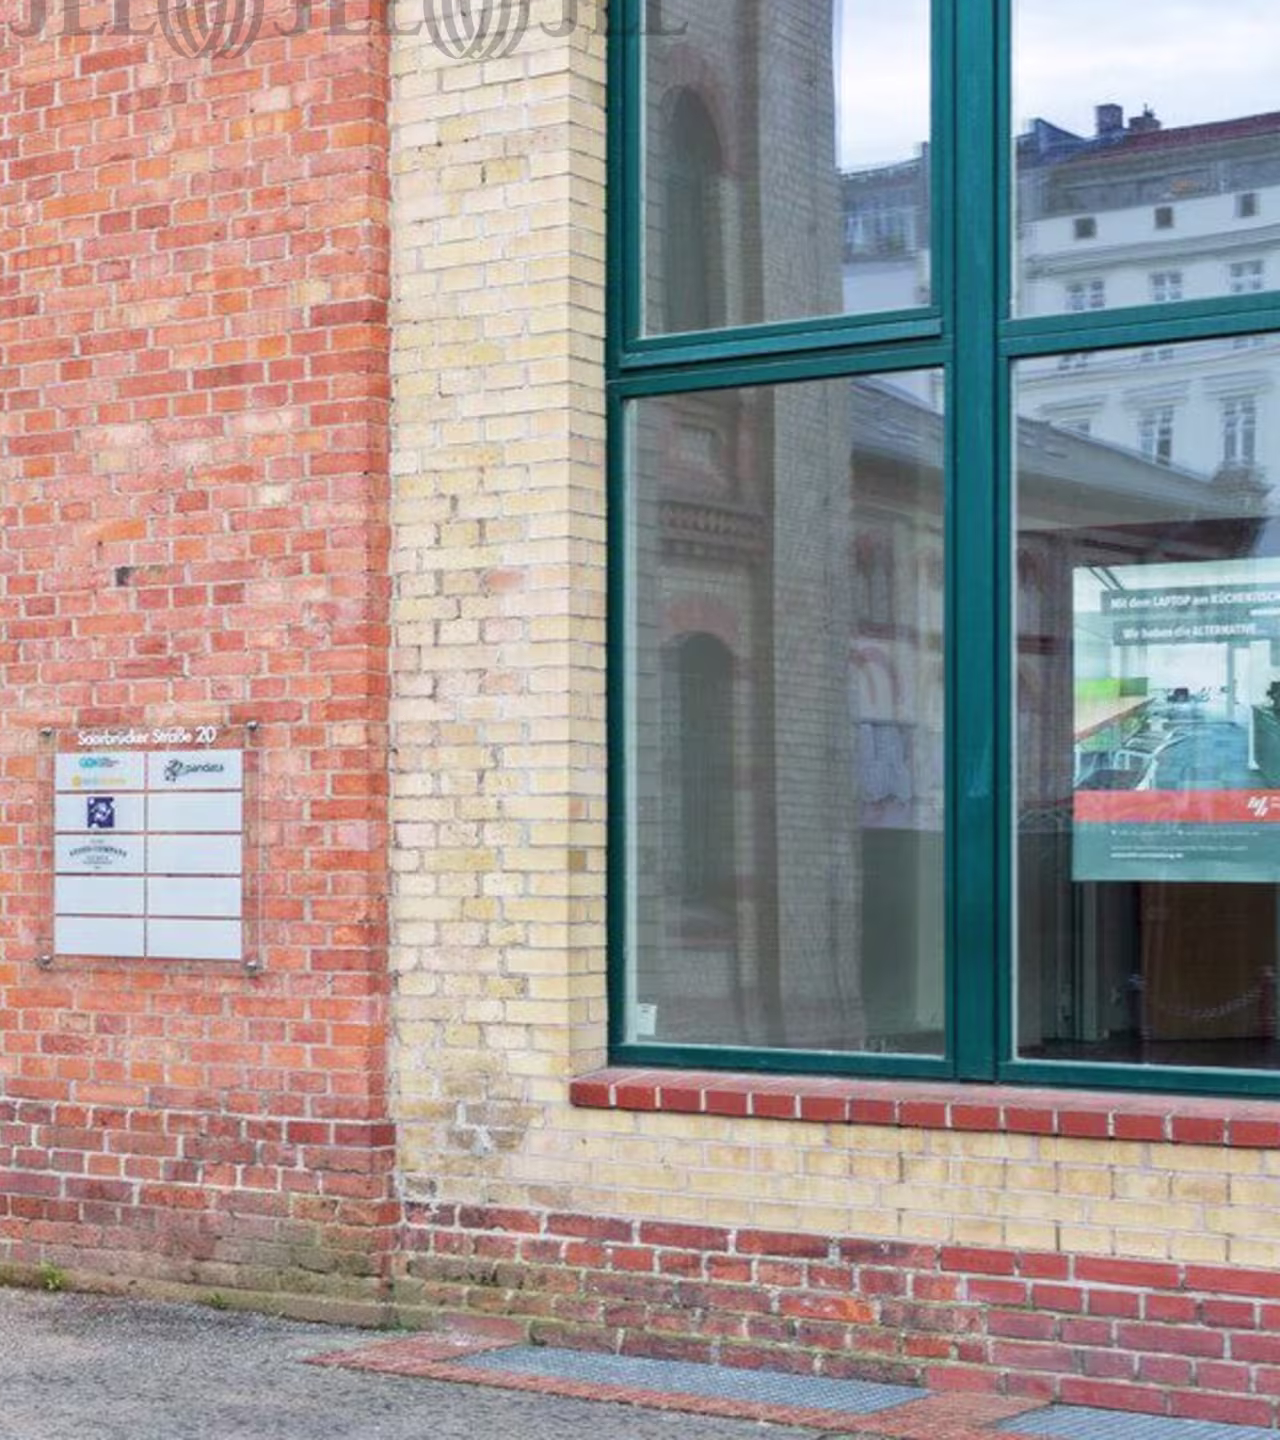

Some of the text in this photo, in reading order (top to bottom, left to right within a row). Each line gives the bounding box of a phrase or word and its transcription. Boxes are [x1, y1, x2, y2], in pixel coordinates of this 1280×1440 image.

[1153, 595, 1190, 607] LAPTOP
[78, 726, 217, 745] Saarbrücker Straße 20
